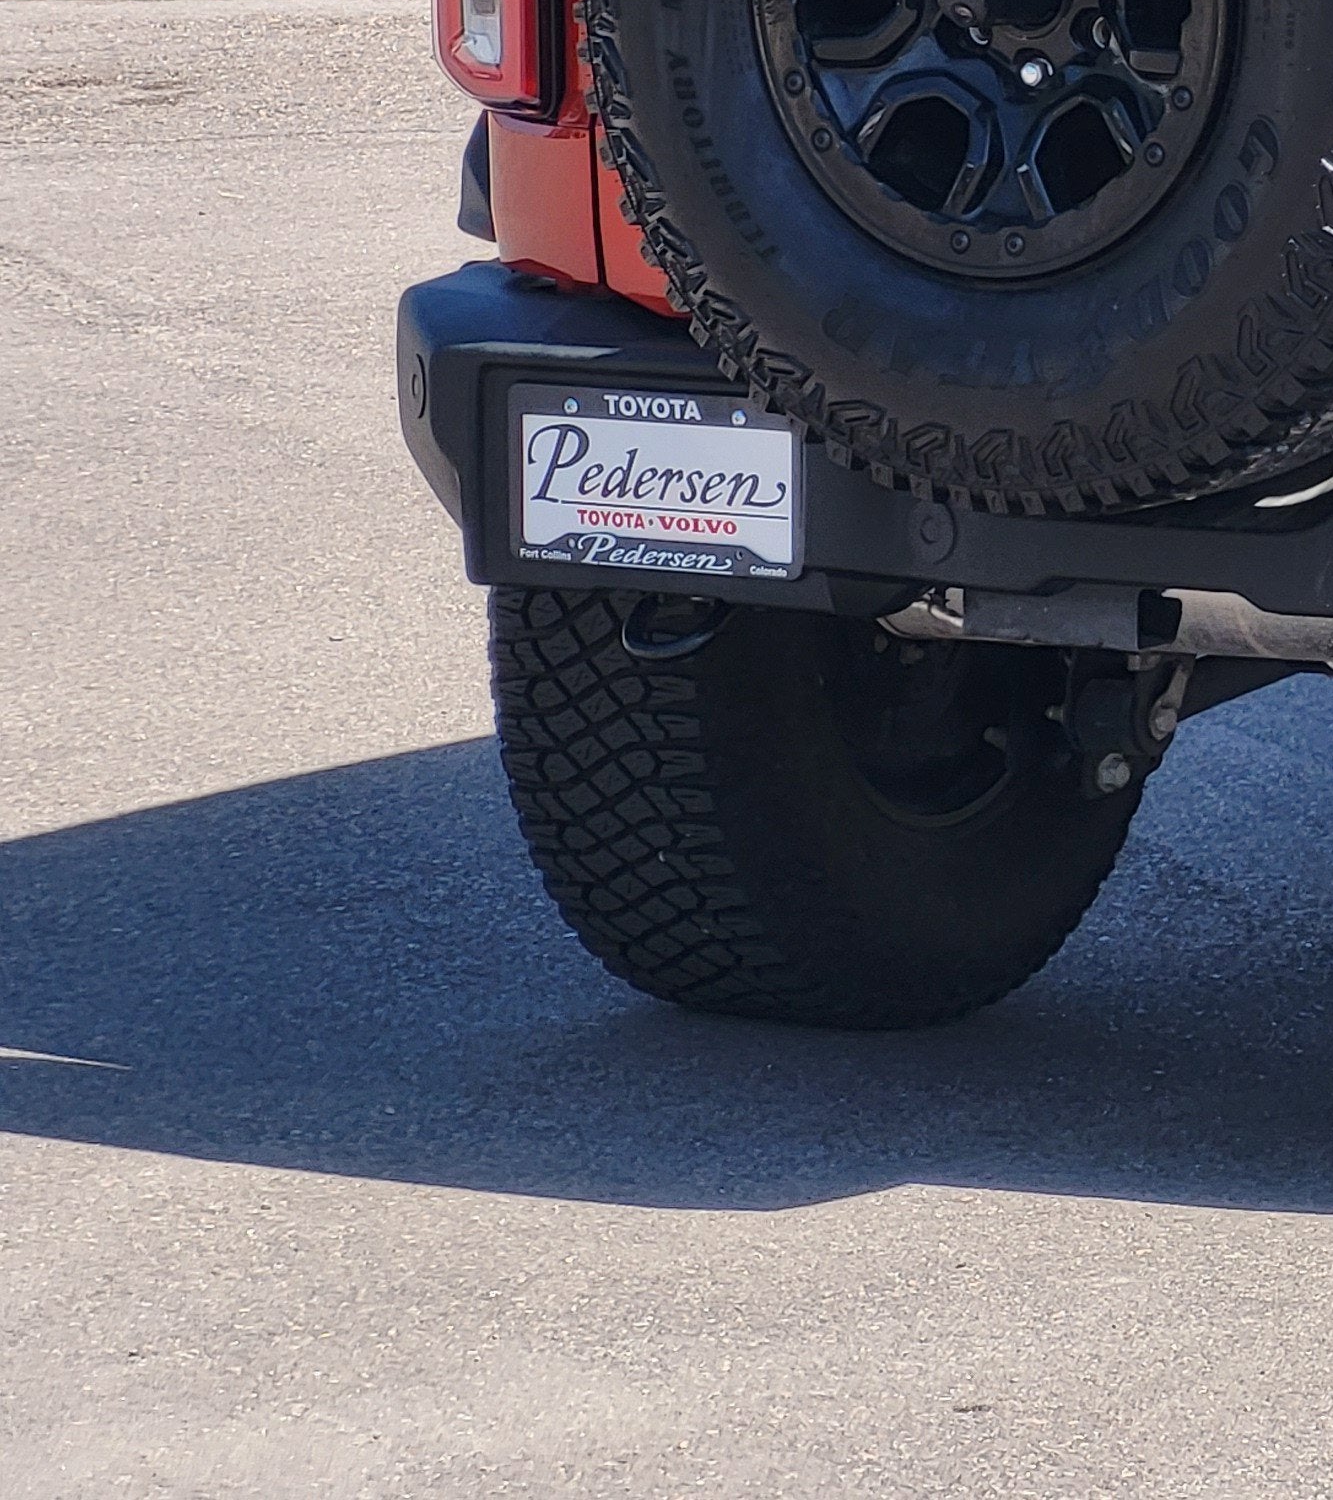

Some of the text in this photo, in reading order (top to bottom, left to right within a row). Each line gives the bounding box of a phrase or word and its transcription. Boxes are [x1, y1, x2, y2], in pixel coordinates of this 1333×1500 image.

[603, 394, 702, 421] TOYOTA
[527, 423, 787, 508] Pedersen
[576, 509, 738, 536] TOYOTA VOLVO
[519, 547, 788, 578] Fort Collins Colorado
[576, 531, 733, 573] Pedersen
